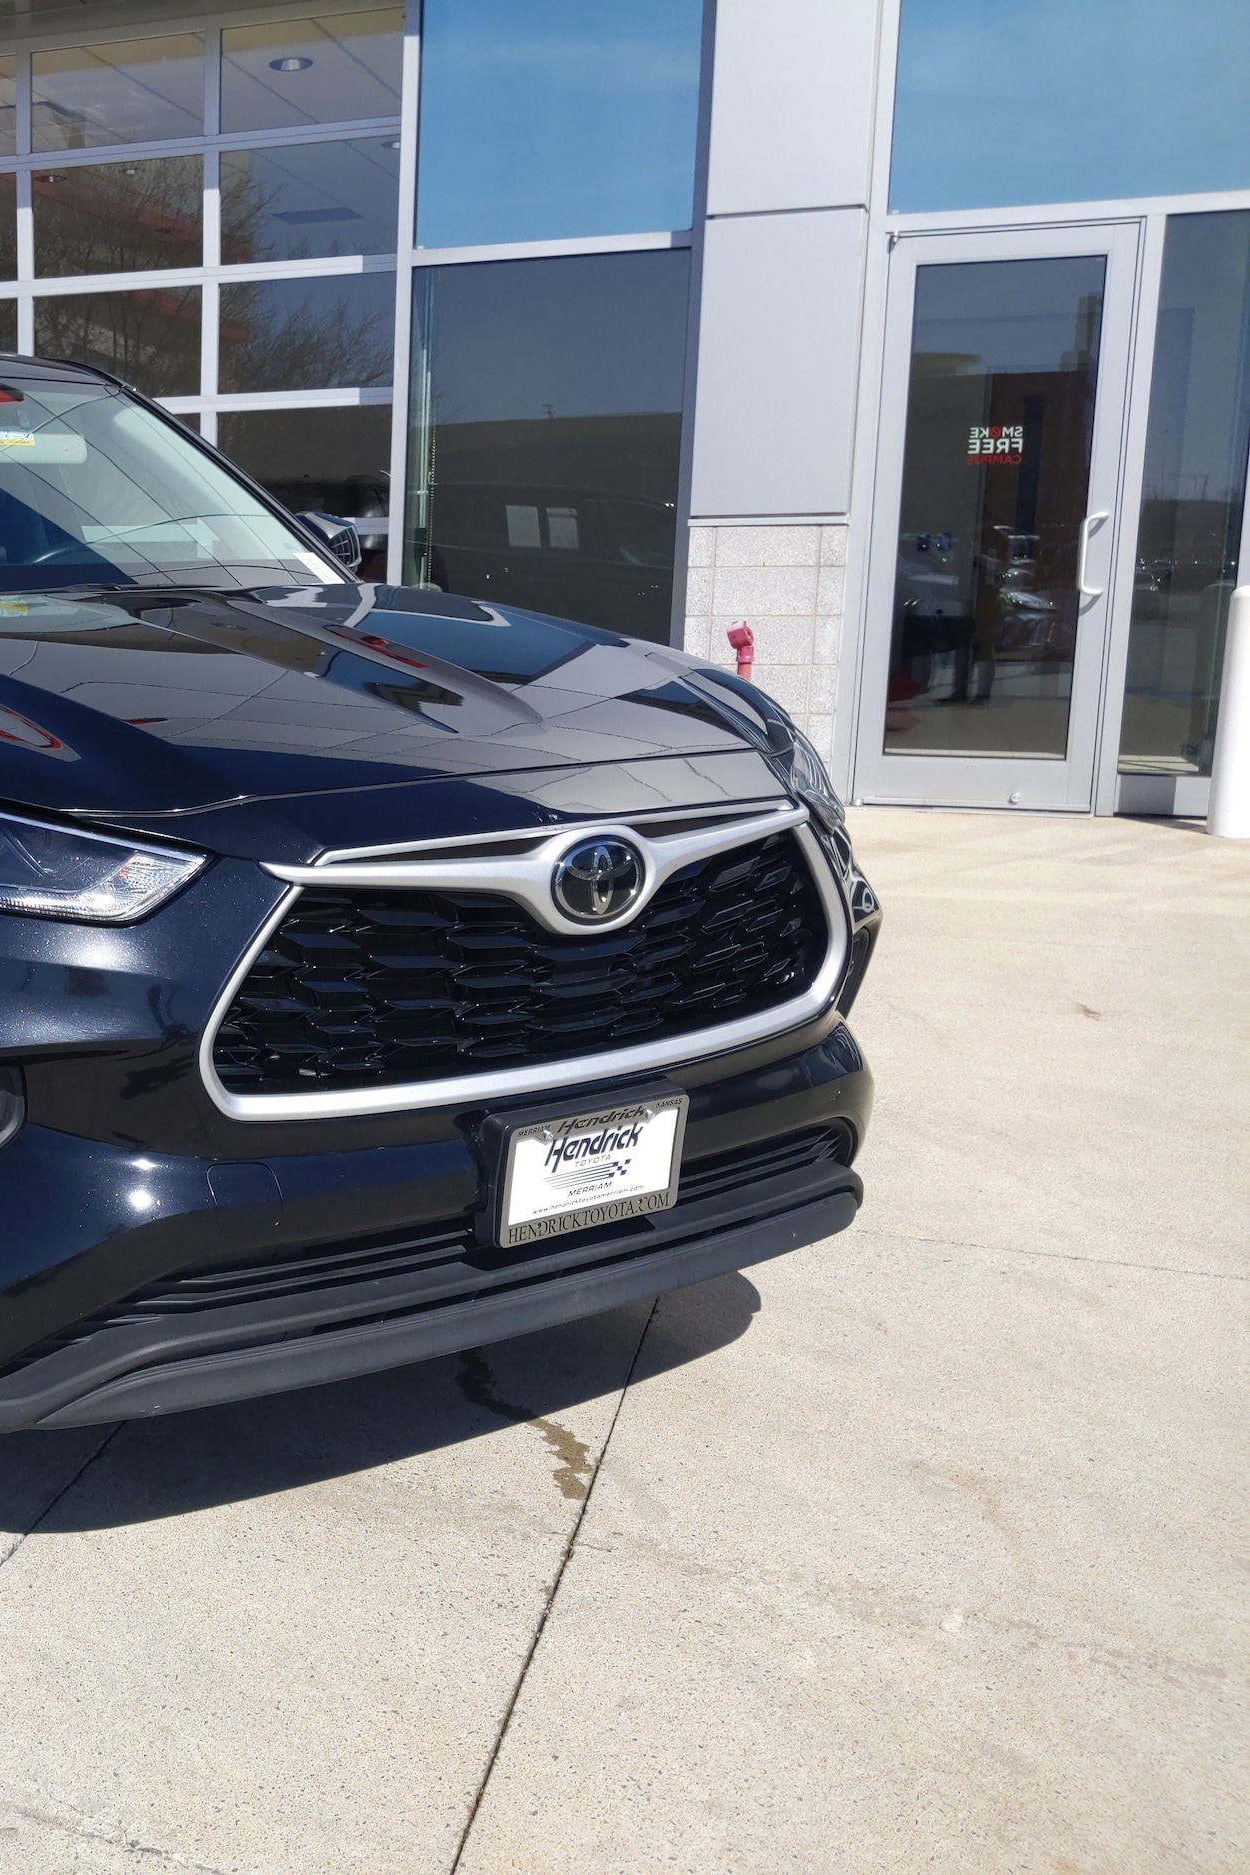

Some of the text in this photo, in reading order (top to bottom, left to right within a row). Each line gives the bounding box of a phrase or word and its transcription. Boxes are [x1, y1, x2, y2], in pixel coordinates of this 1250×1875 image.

[655, 1097, 683, 1108] KANSAS
[517, 1124, 551, 1137] MERRIAM
[557, 1105, 646, 1134] Hendrick
[544, 1122, 643, 1174] Hendrick
[574, 1154, 611, 1168] TOYOTA
[532, 1184, 644, 1215] www.hendricktoyotamerriam.com
[568, 1181, 613, 1197] MERRIAM
[508, 1191, 671, 1244] HENDRICKTOYOTA.COM
